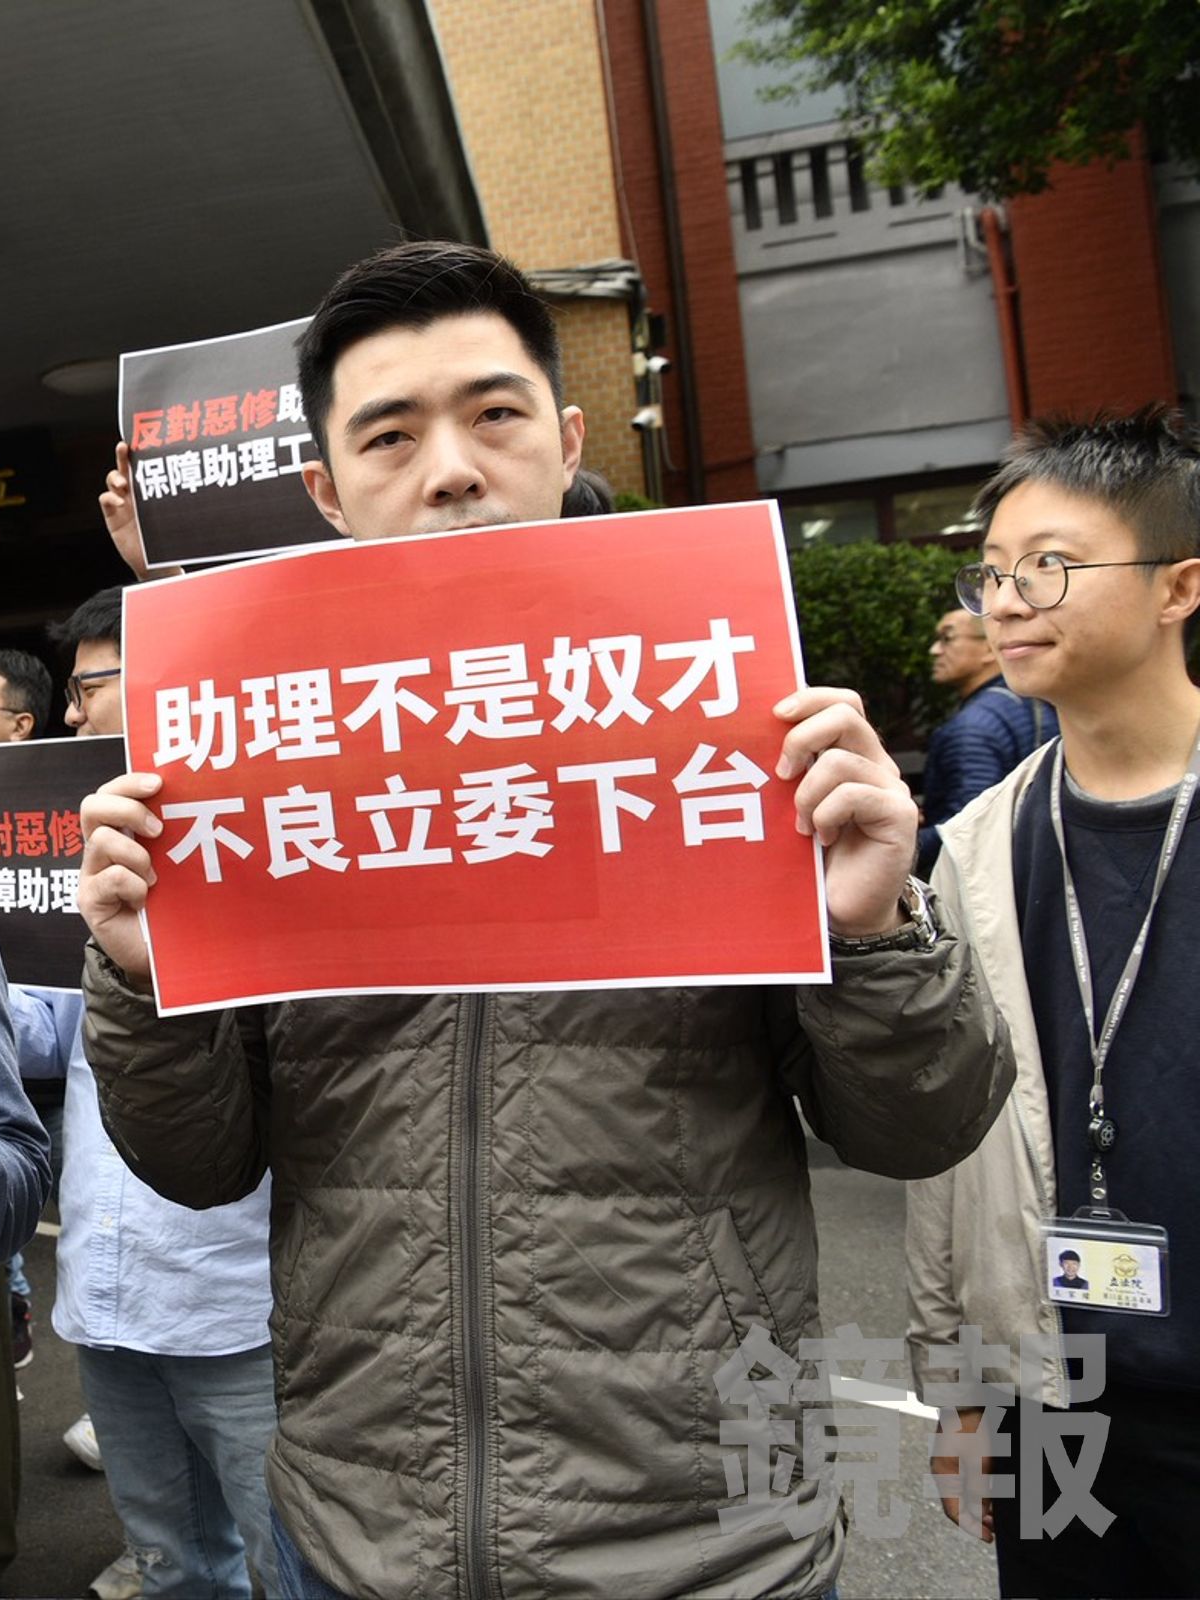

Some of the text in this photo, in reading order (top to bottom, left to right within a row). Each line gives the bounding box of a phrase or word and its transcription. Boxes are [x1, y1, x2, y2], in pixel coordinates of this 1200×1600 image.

[135, 433, 312, 501] 保障助理工
[152, 618, 757, 772] 助理不是奴才
[161, 743, 770, 883] 不良立委下台
